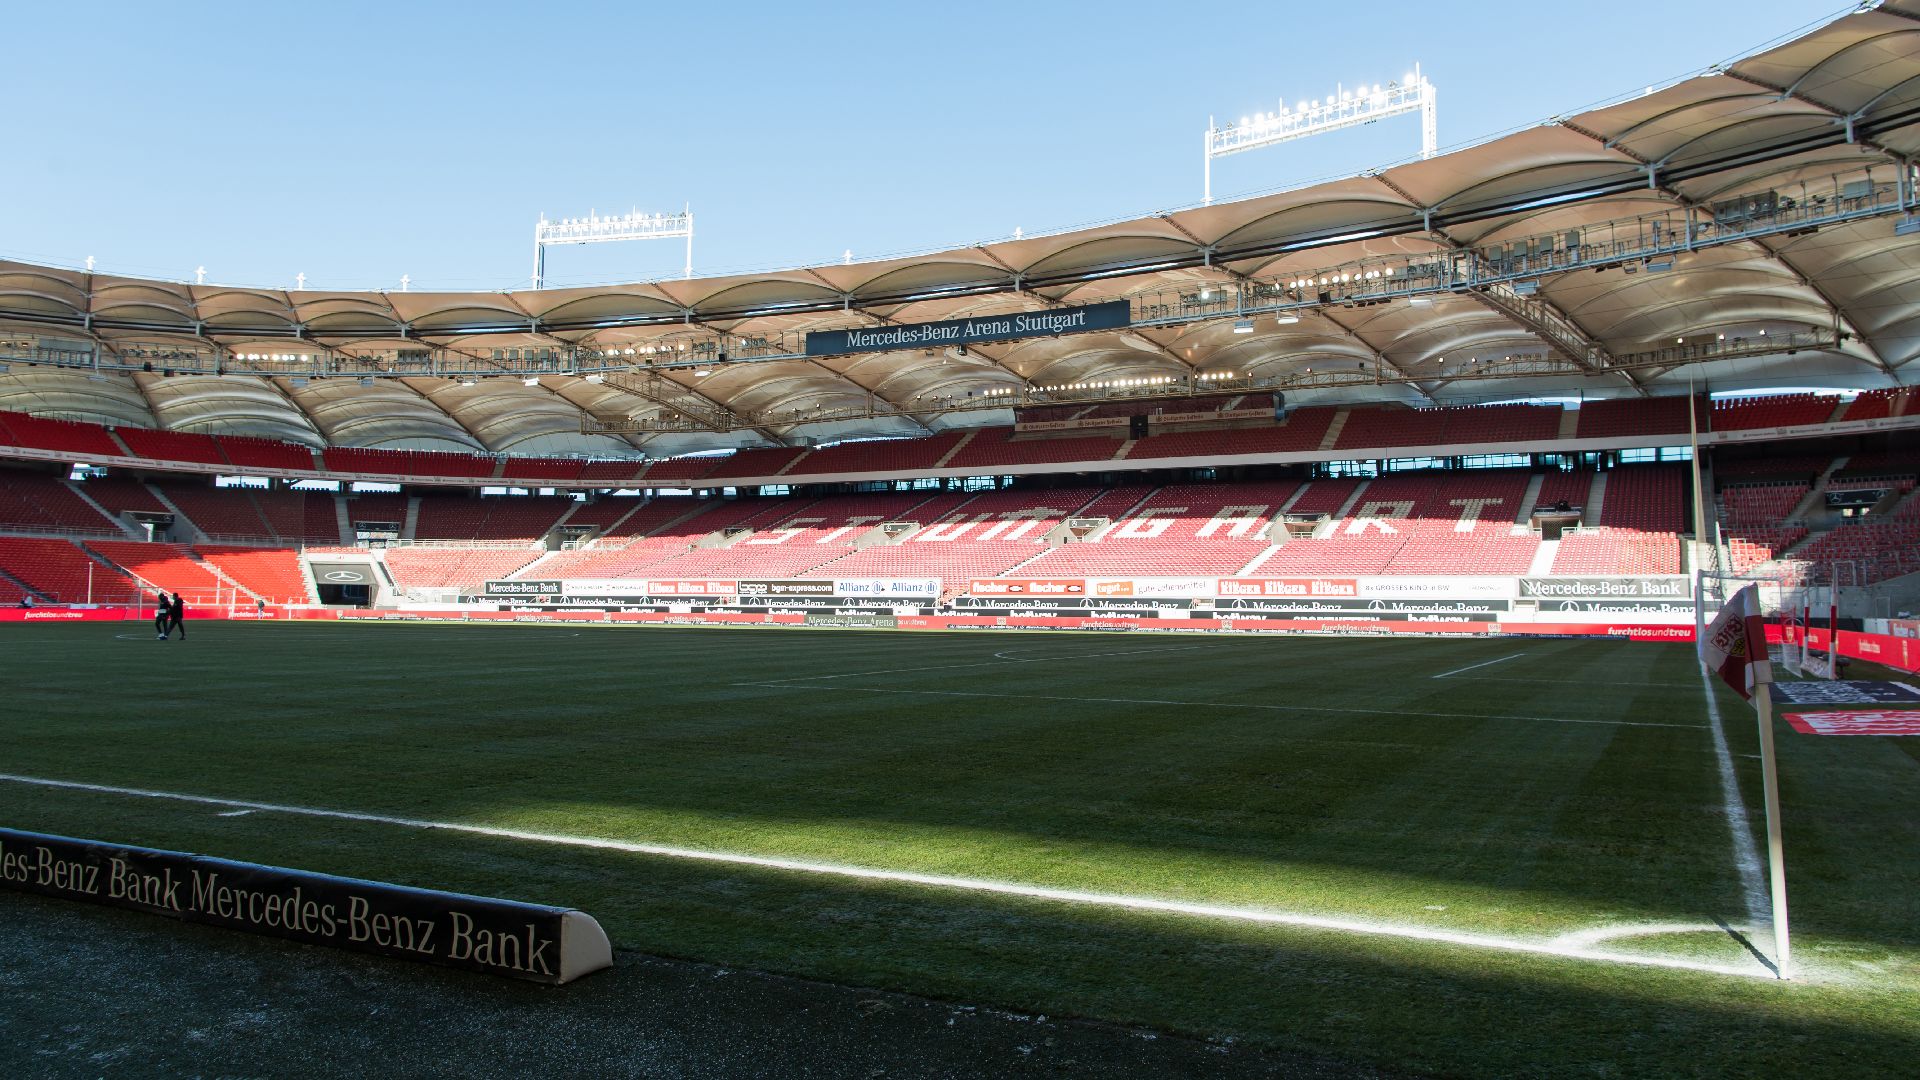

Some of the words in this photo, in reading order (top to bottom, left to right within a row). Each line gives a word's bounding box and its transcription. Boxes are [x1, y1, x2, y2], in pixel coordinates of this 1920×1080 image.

[846, 325, 959, 348] Mercedes-Benz
[964, 319, 1011, 338] Arena
[1015, 309, 1086, 335] Stuttgart
[489, 582, 539, 593] Mercedes-Benz
[540, 582, 559, 593] Bank
[771, 583, 833, 593] bgm-express.com
[839, 582, 869, 592] Allianz
[892, 582, 923, 592] Allianz
[972, 582, 1008, 592] fischer
[1029, 582, 1067, 592] fischer
[1528, 581, 1638, 595] Mercedes-Benz
[1641, 581, 1681, 595] Bank
[1391, 602, 1489, 611] Mercedes-Benz
[1607, 626, 1691, 637] furchtlosundtreu
[109, 857, 184, 911] Bank
[189, 870, 437, 956] Mercedes-Benz
[448, 912, 555, 976] Bank
